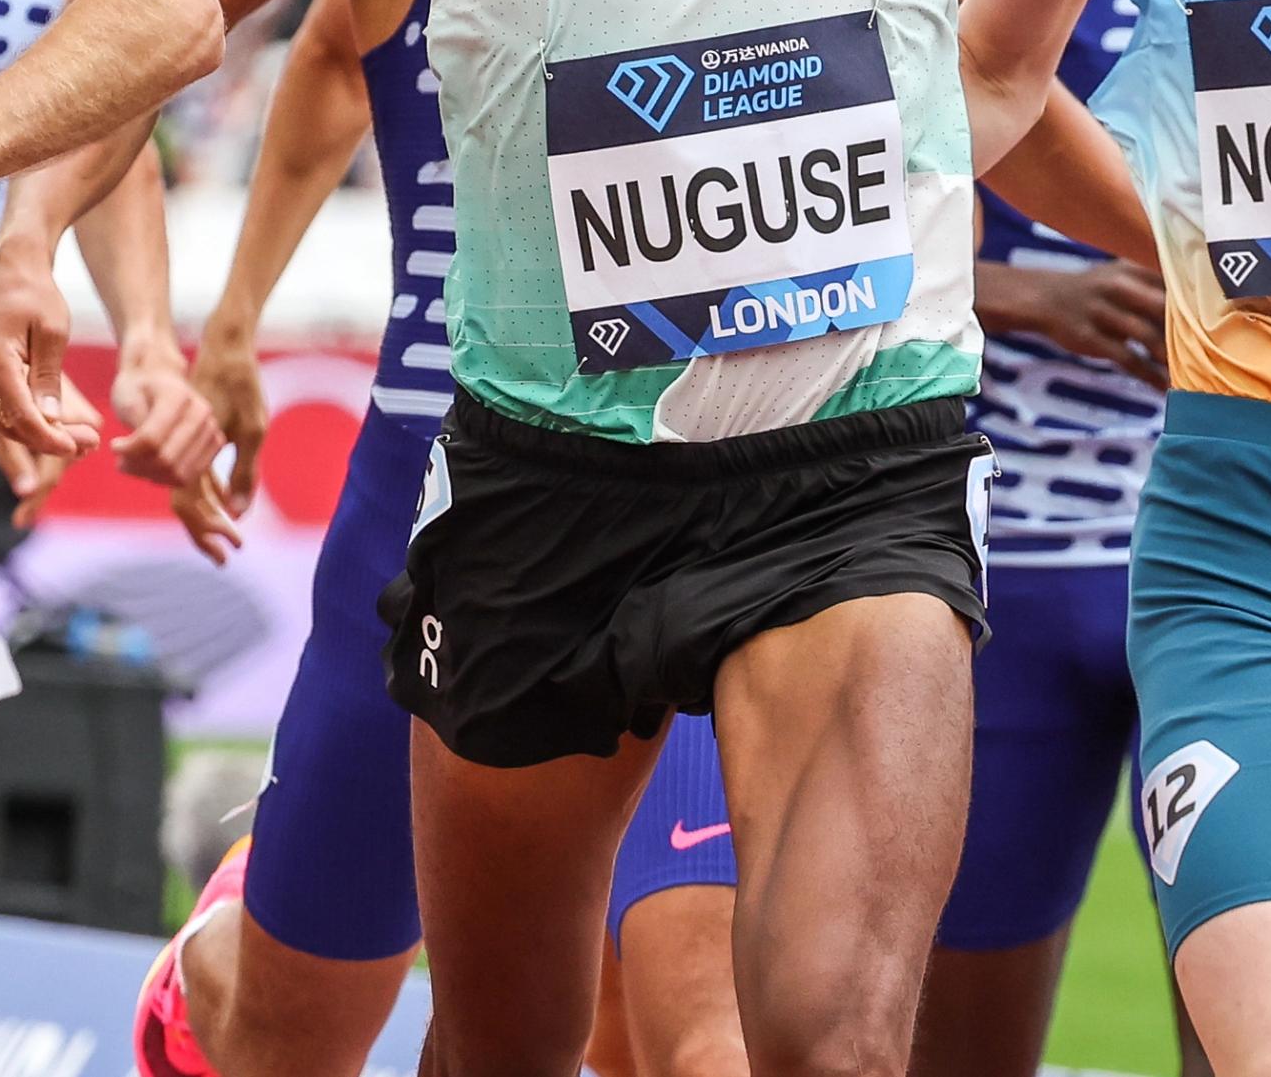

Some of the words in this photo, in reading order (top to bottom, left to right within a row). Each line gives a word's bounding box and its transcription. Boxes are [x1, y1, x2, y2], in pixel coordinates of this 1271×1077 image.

[703, 84, 803, 122] LEAGUE
[704, 55, 822, 96] DIAMOND
[570, 139, 890, 272] NUGUSE
[709, 276, 876, 339] LONDON
[1147, 763, 1197, 855] 12
